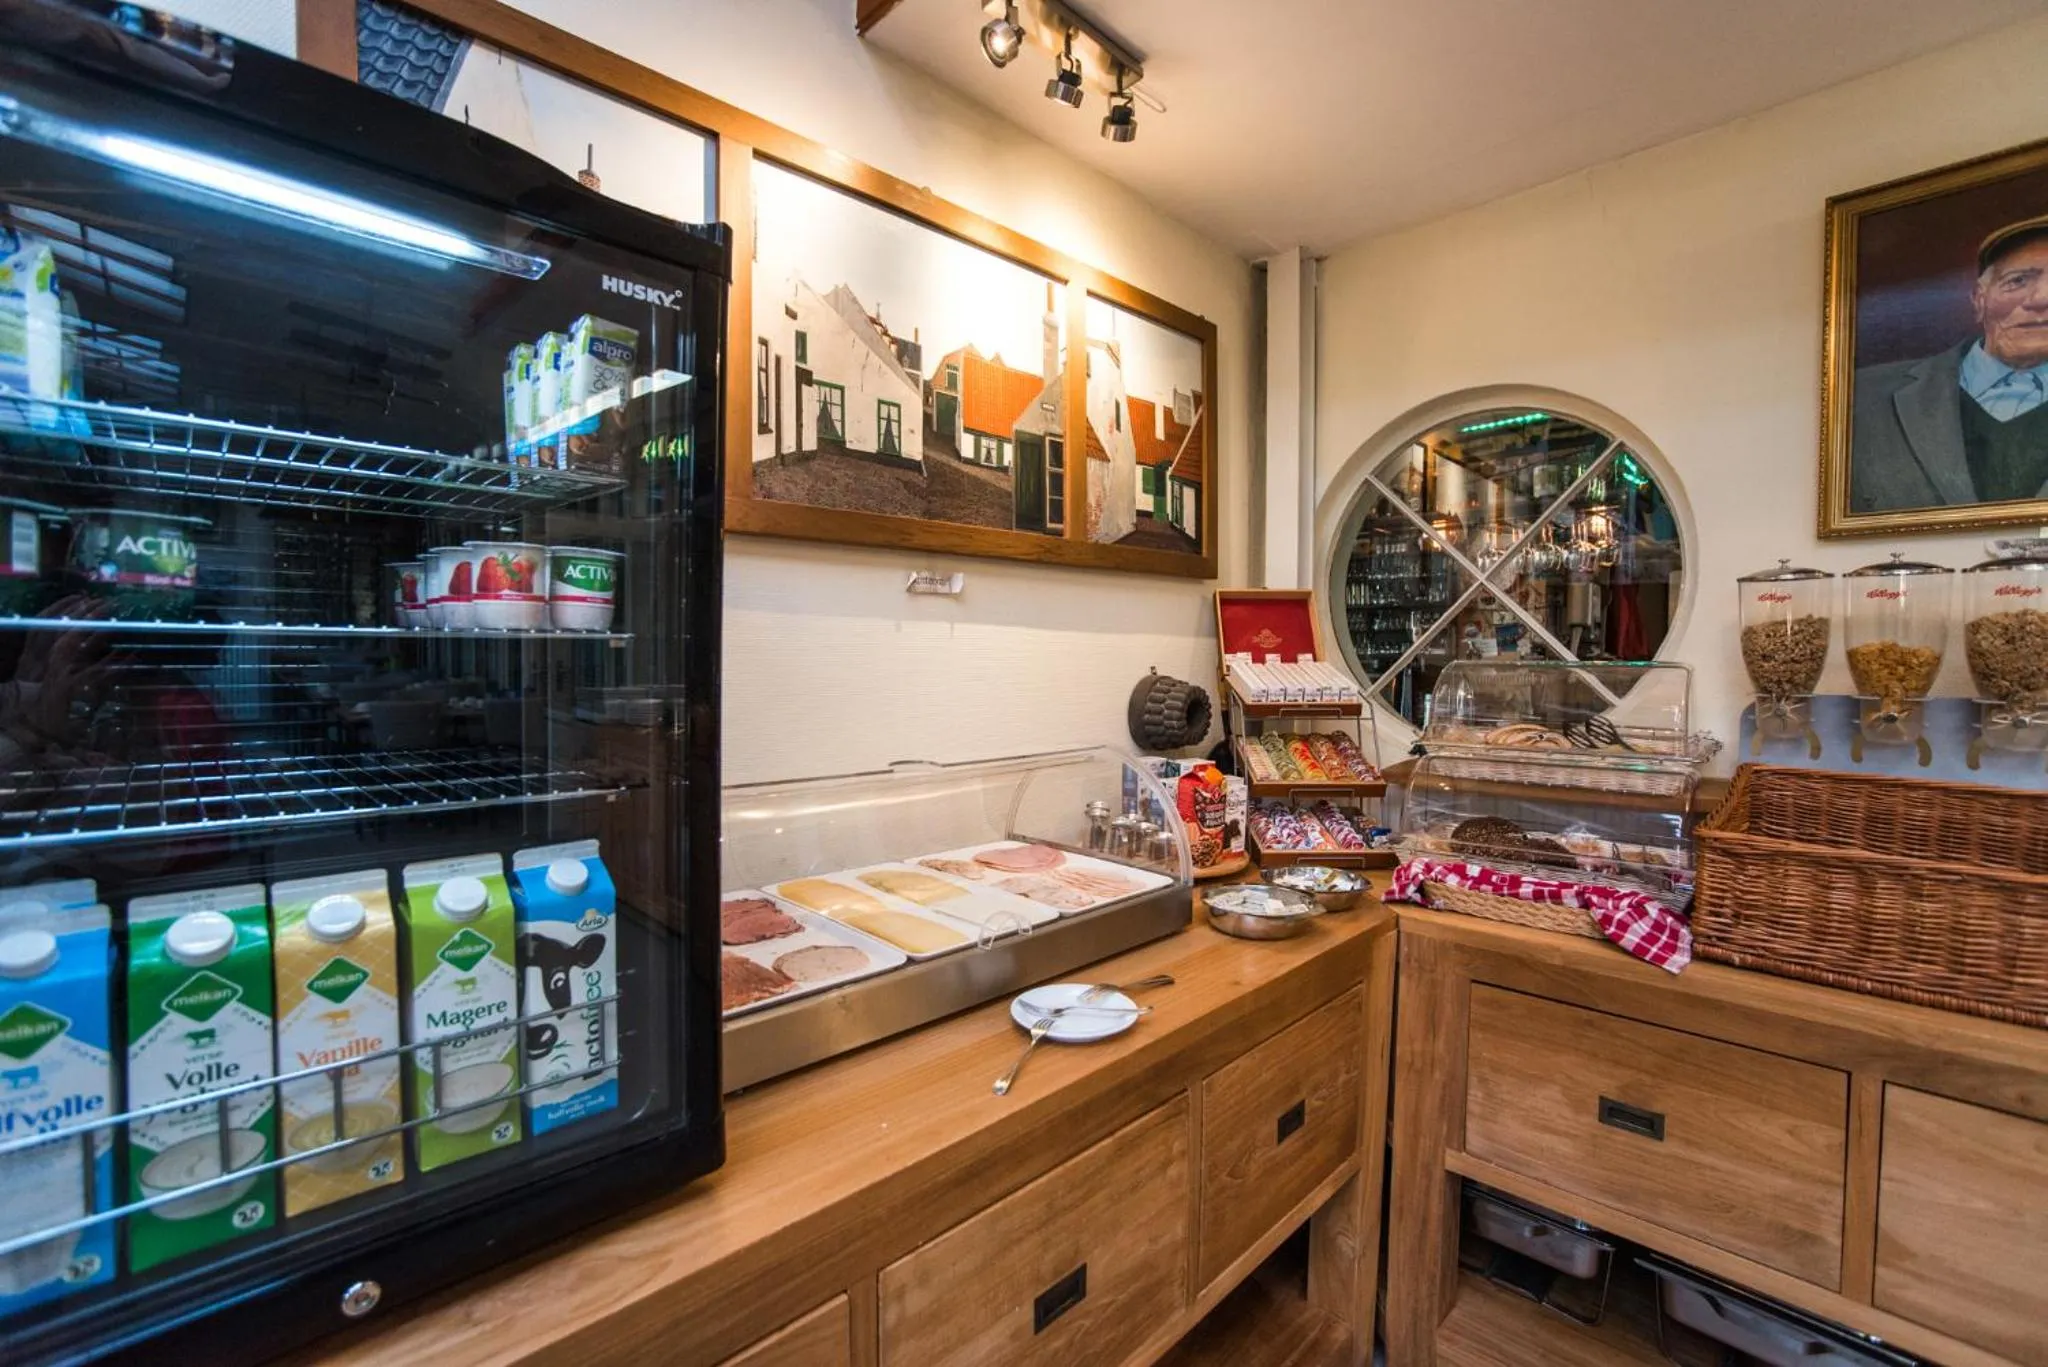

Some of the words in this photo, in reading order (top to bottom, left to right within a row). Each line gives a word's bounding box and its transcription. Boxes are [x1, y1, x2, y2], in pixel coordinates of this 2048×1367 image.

[602, 274, 676, 308] HUSKY
[592, 339, 632, 361] alpro
[580, 914, 604, 928] Arla
[427, 1000, 508, 1032] Magere
[296, 1036, 383, 1068] Vanille
[165, 1062, 240, 1091] Volle
